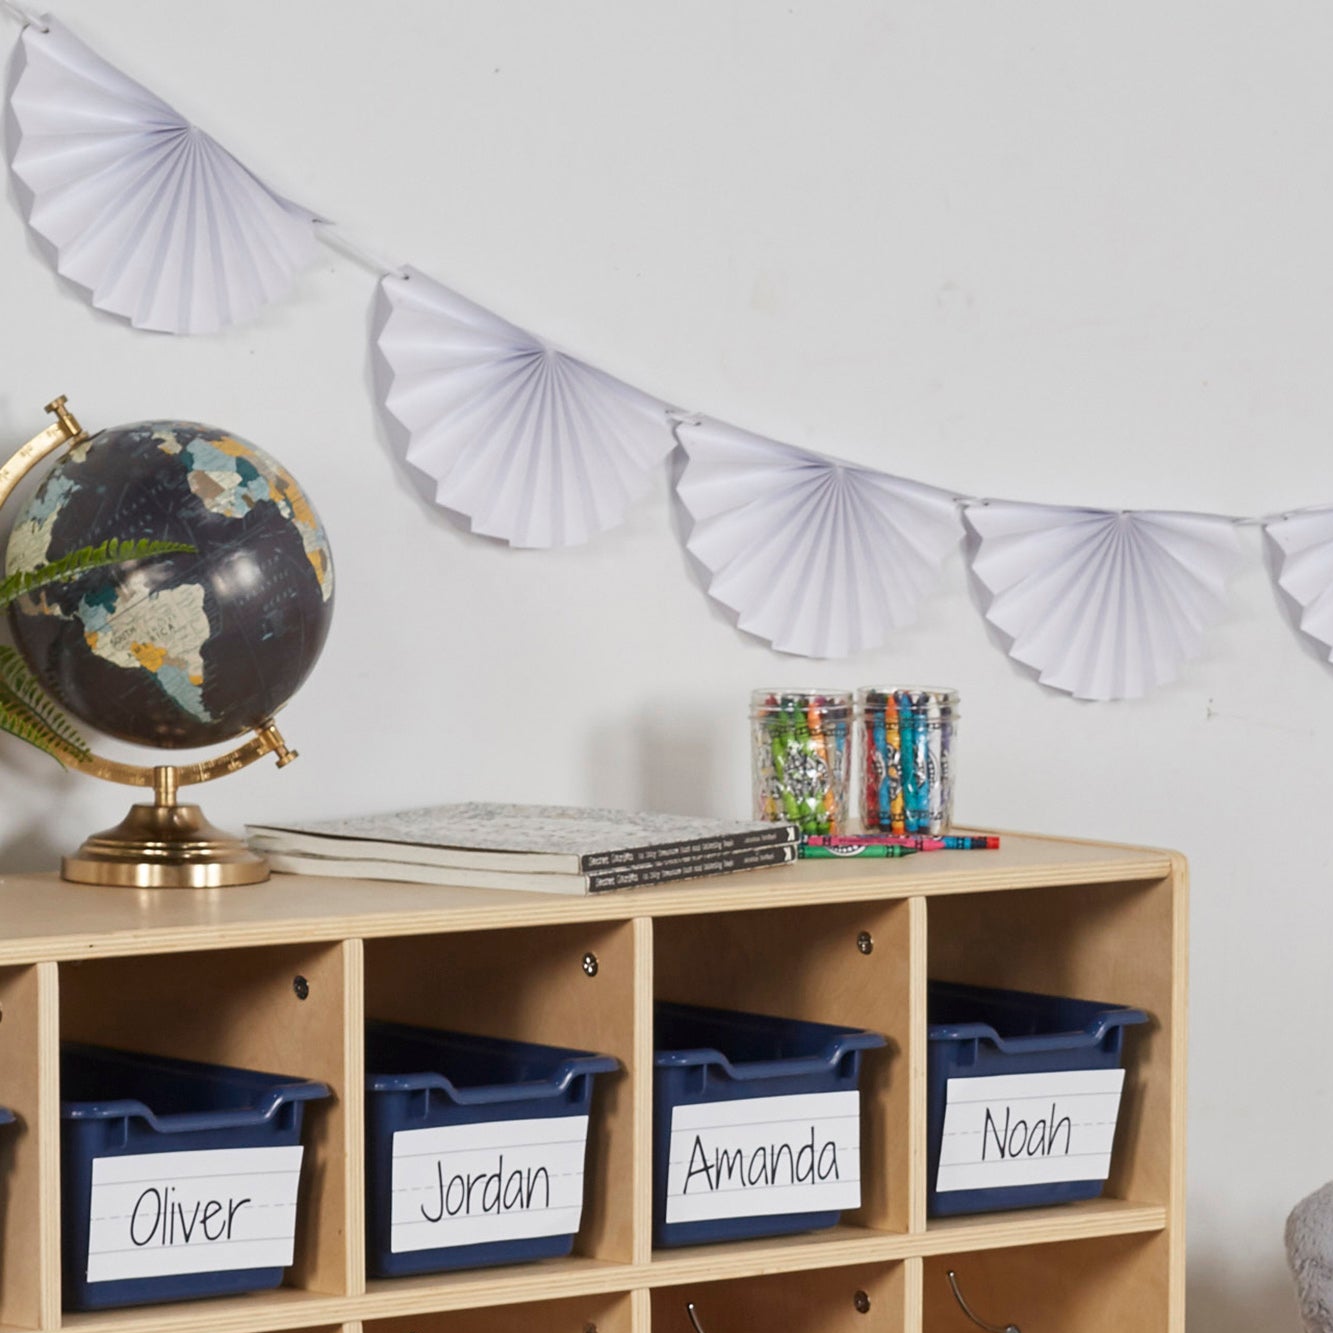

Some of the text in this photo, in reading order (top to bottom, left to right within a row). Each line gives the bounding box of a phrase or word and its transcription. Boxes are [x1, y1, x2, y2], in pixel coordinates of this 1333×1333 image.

[683, 1125, 840, 1195] Amanda
[981, 1102, 1072, 1162] Noah
[129, 1186, 252, 1247] Oliver
[420, 1153, 550, 1223] Jordan
